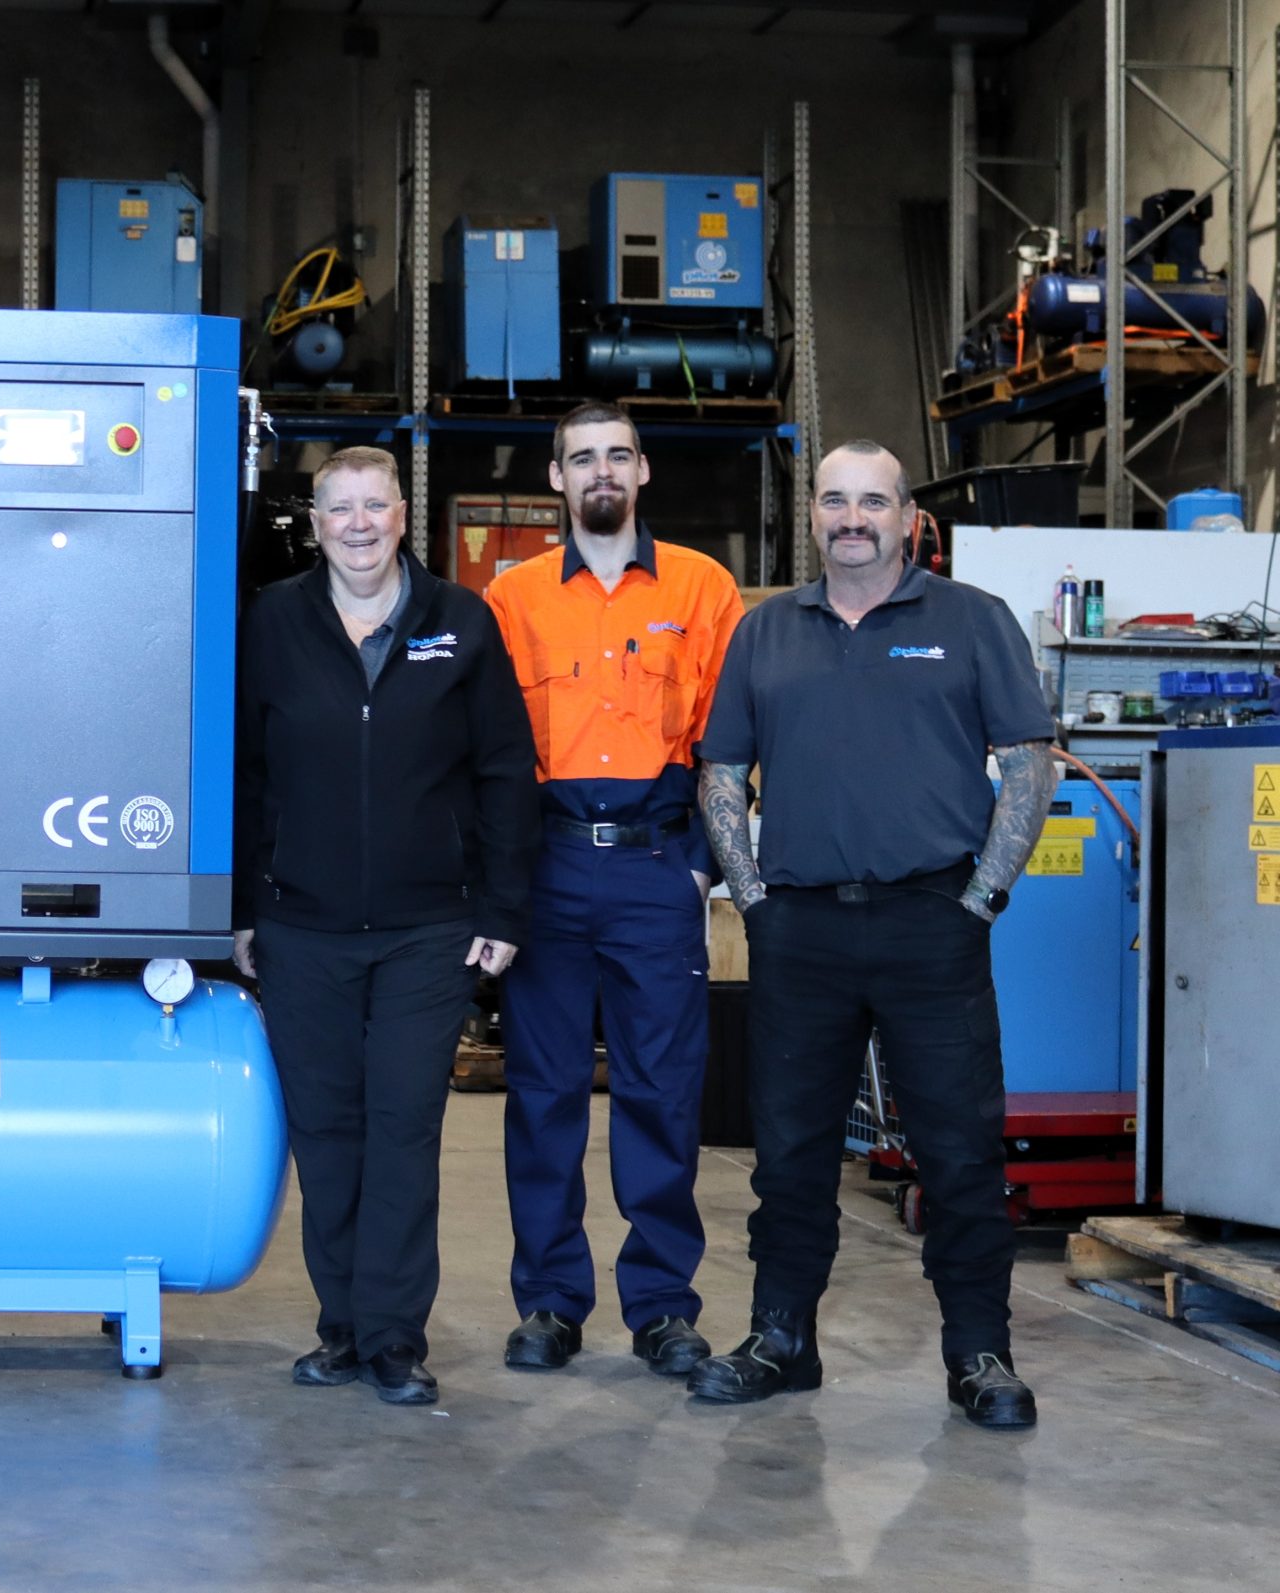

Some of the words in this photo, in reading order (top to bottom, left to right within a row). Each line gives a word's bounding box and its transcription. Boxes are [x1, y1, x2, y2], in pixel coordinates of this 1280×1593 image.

[407, 650, 455, 661] HONDA
[135, 808, 160, 821] ISO
[43, 795, 109, 848] CE
[133, 820, 160, 832] 9001
